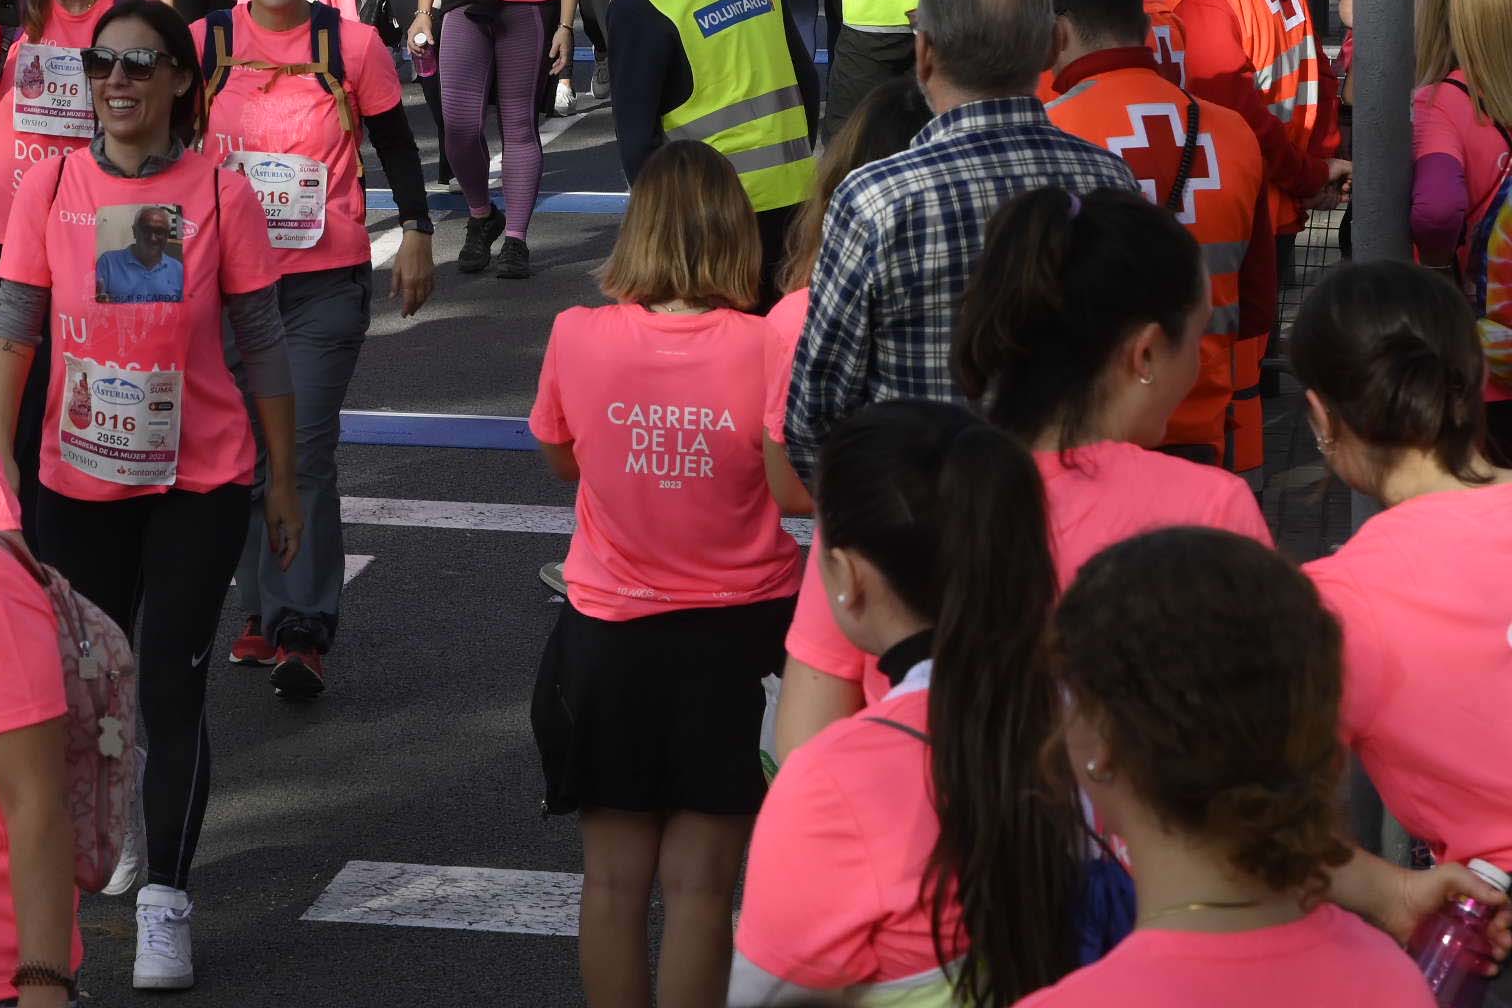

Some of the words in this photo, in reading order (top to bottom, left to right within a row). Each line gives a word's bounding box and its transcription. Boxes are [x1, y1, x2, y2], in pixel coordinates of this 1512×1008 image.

[47, 81, 80, 96] 016
[51, 98, 72, 108] 7928
[21, 117, 48, 128] OYSHO
[59, 313, 88, 344] TU
[96, 383, 141, 402] ASTURIANA
[94, 410, 137, 432] 016
[607, 402, 737, 432] CARRERA
[70, 436, 98, 453] CARRERA
[109, 448, 120, 458] LA
[120, 450, 146, 461] MUJER
[96, 431, 130, 447] 29552
[631, 428, 665, 452] DE
[677, 431, 711, 454] LA
[68, 450, 98, 470] OYSHO
[625, 452, 715, 478] MUJER
[127, 468, 167, 478] Santander
[658, 480, 683, 490] 2023
